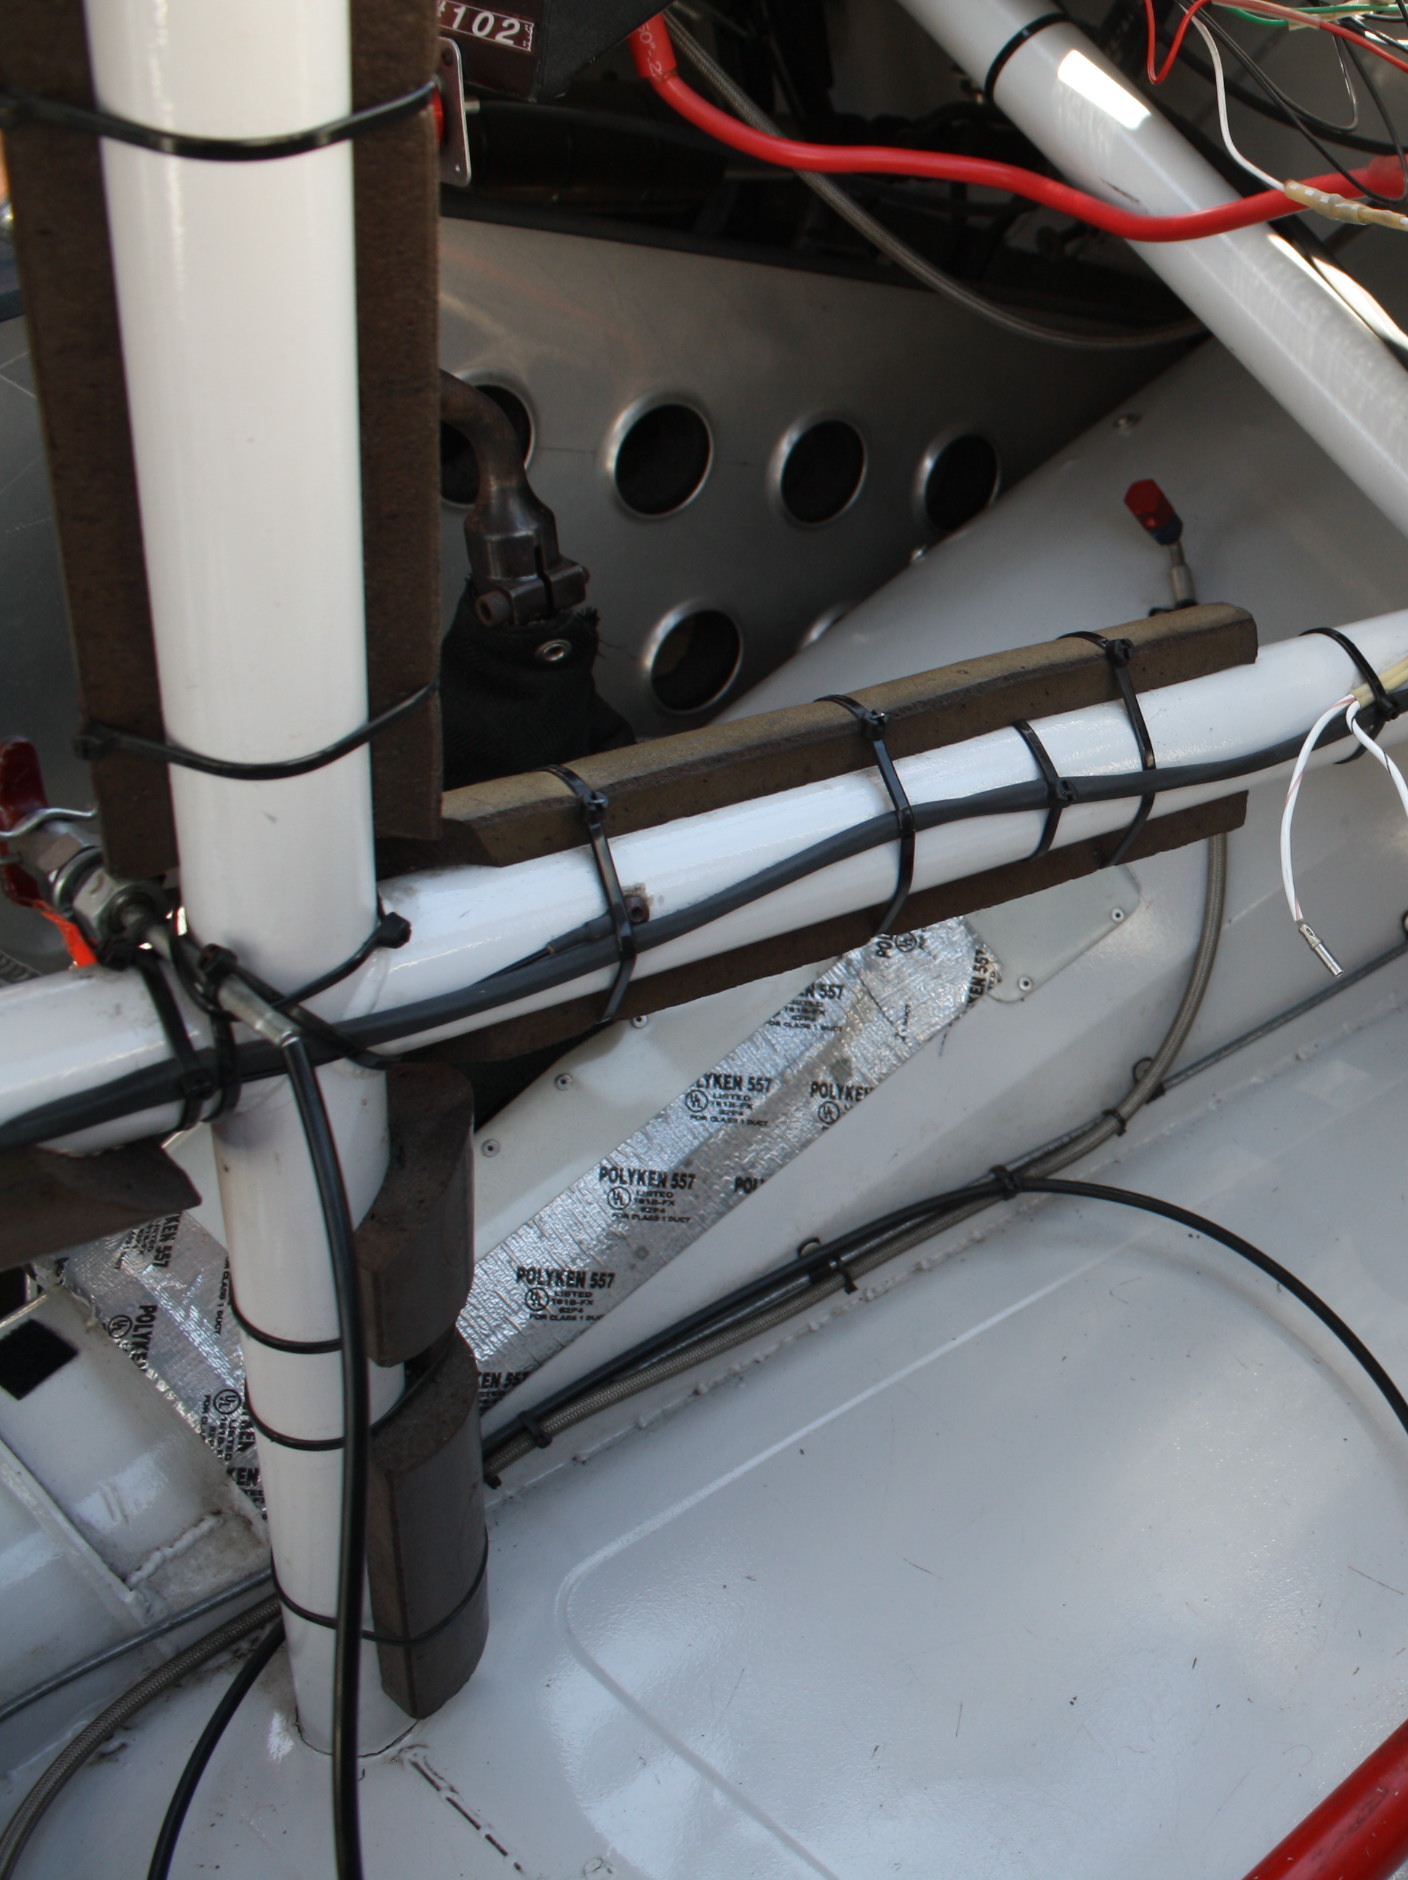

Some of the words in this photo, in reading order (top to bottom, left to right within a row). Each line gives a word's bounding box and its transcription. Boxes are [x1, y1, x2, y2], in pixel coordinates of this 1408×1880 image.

[747, 1076, 773, 1094] 557
[598, 1166, 668, 1189] POLYKEN
[670, 1172, 697, 1190] 557
[515, 1266, 587, 1289] POLYKEN
[589, 1271, 616, 1289] 557
